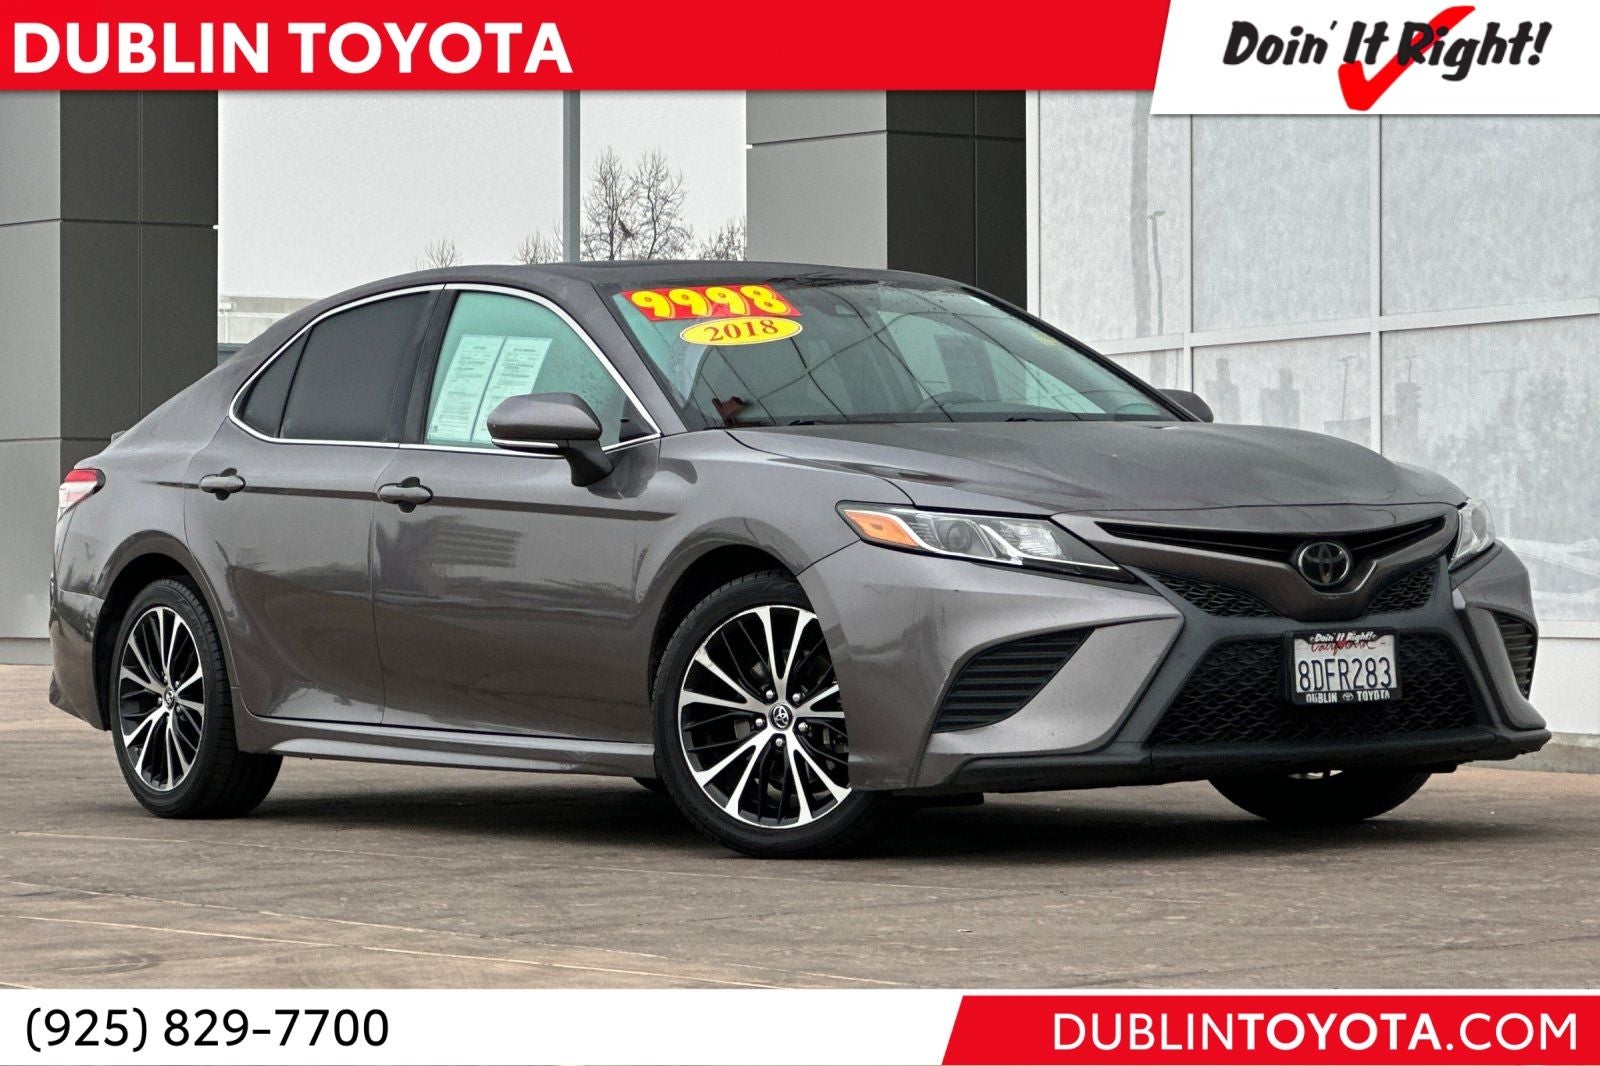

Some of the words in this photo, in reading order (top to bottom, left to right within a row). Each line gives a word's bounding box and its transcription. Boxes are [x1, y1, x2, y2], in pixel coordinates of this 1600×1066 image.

[631, 285, 791, 319] 9998
[703, 319, 779, 342] 2018
[1298, 656, 1393, 692] 8DFR283
[1306, 692, 1338, 703] DUBLIN
[1357, 690, 1391, 702] TOYOTA
